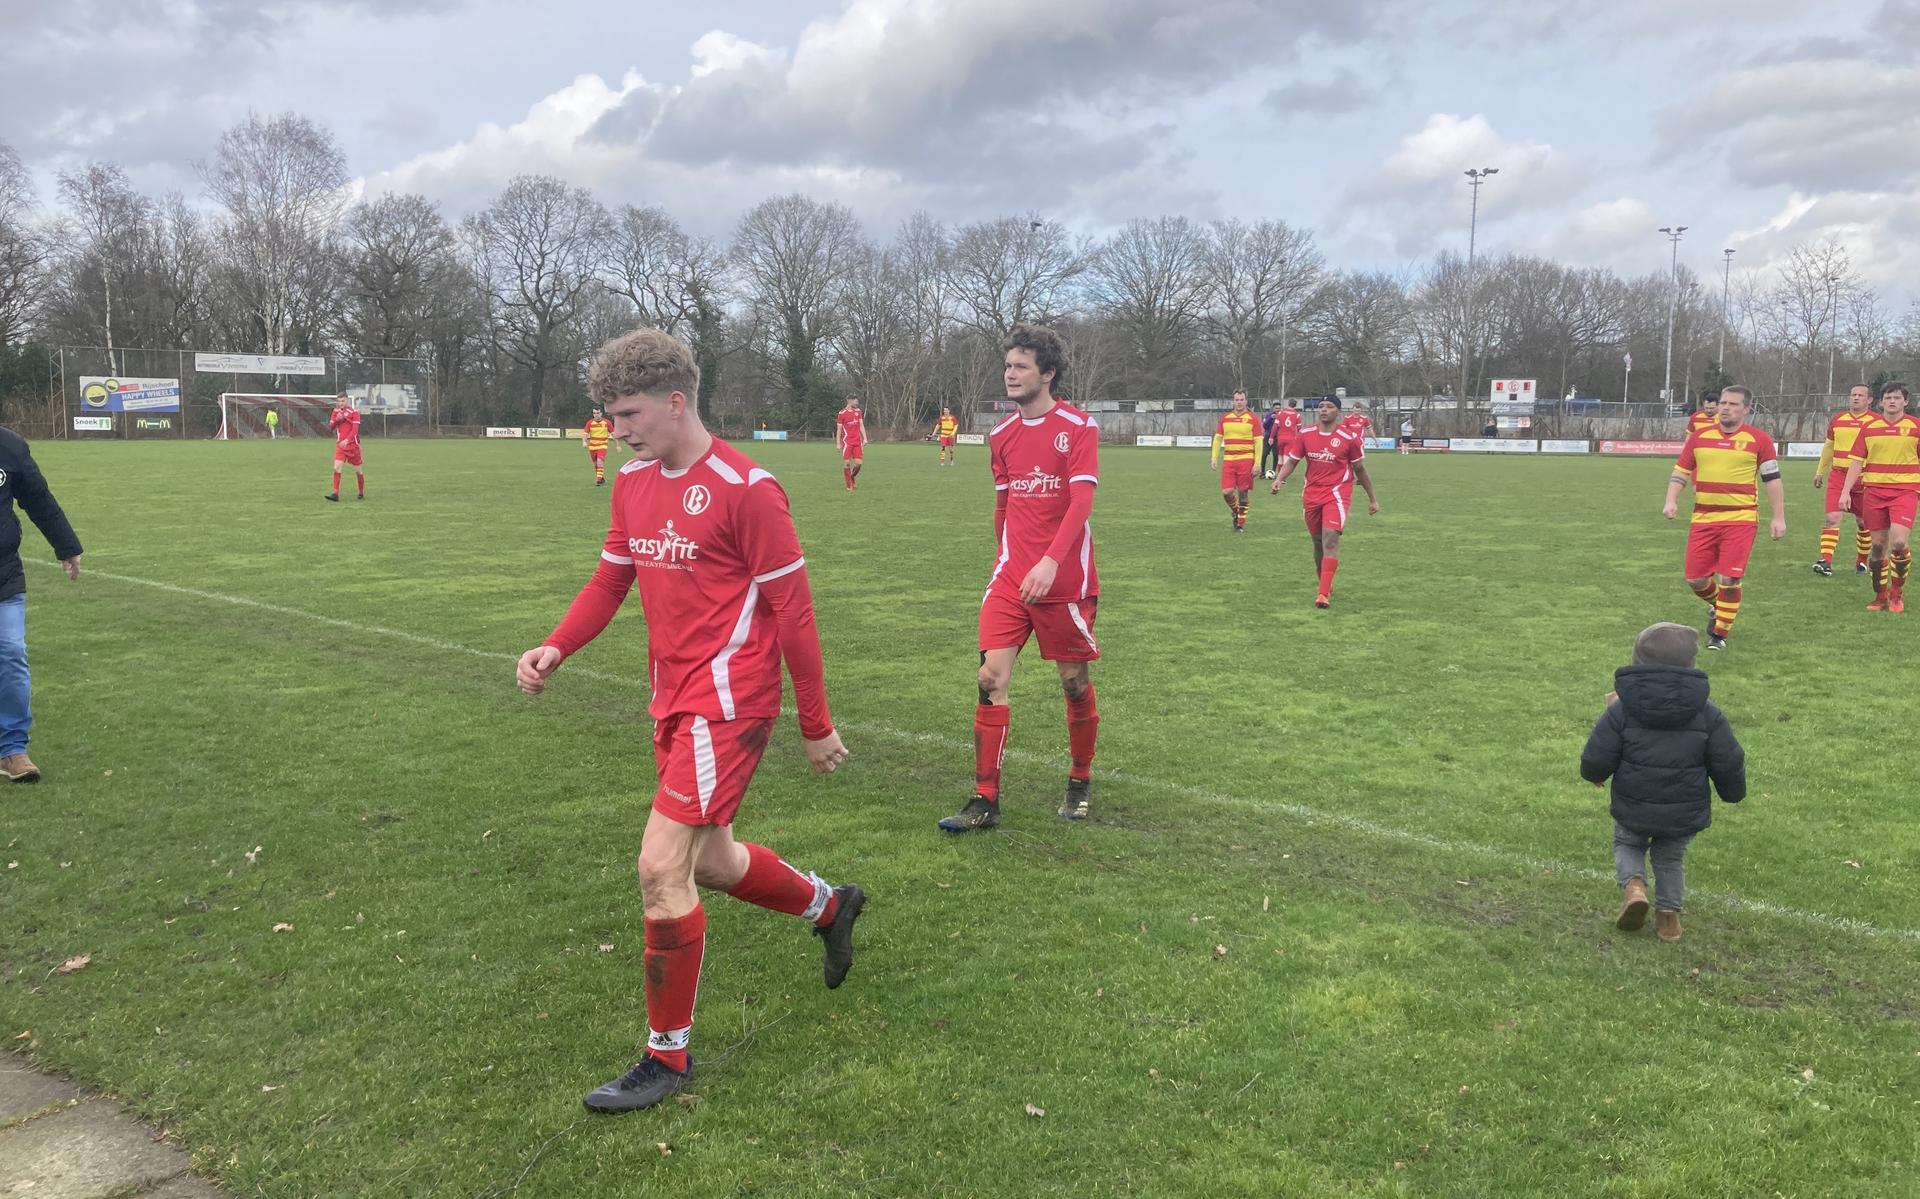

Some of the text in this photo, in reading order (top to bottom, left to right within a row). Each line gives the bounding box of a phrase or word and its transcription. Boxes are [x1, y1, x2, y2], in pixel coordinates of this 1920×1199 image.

[121, 389, 175, 400] HAPPY WHEELS
[1284, 416, 1292, 427] 6
